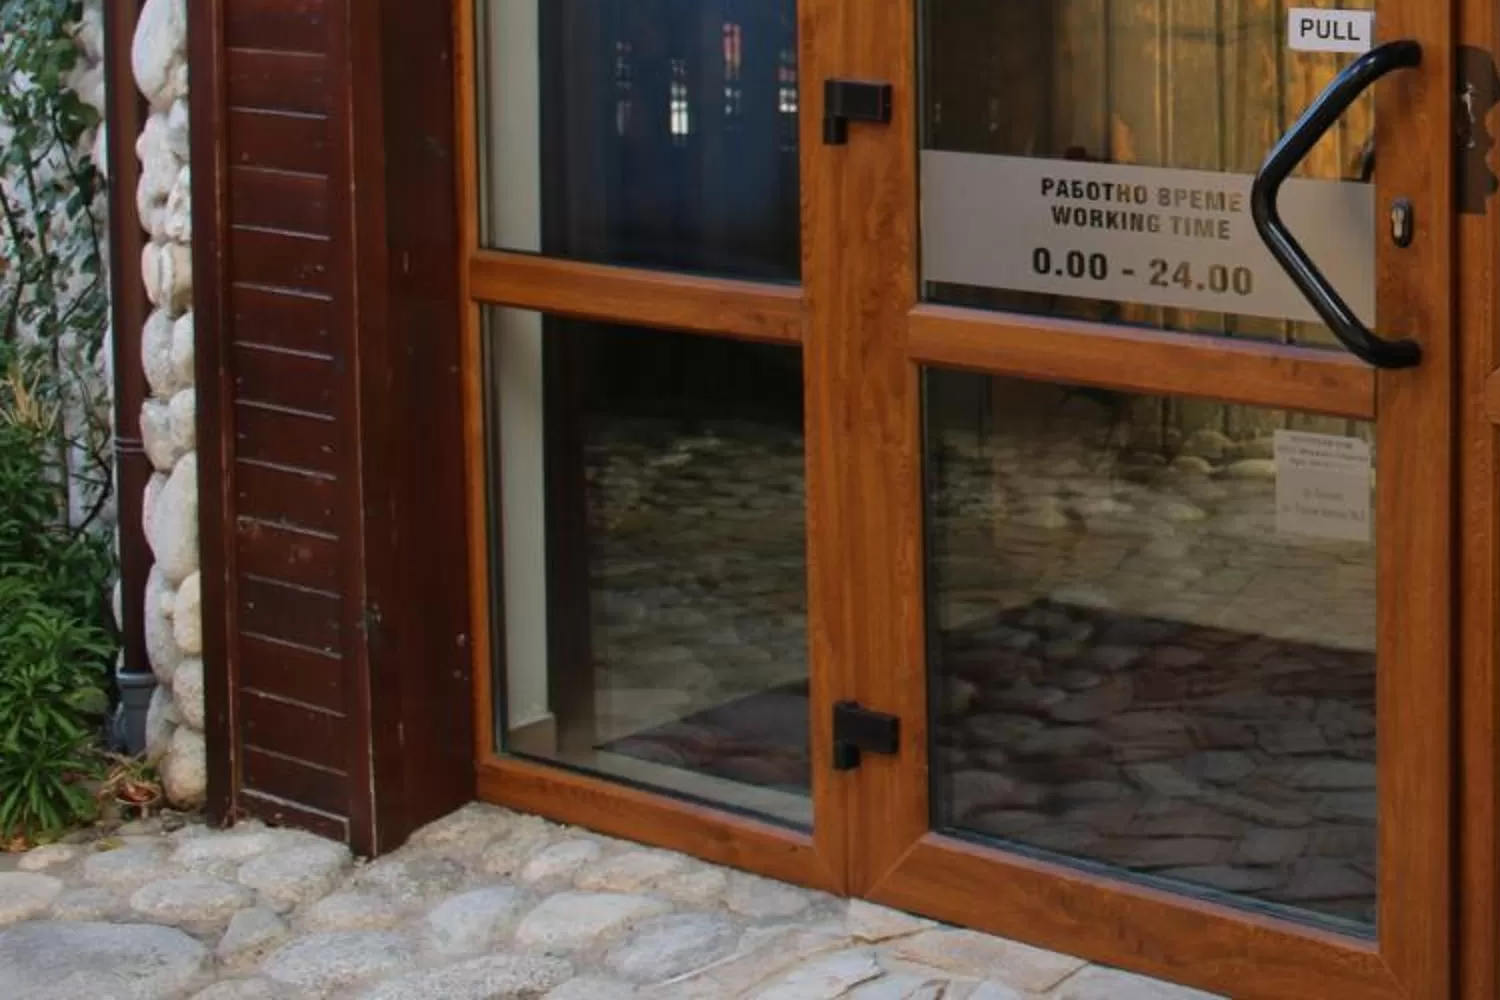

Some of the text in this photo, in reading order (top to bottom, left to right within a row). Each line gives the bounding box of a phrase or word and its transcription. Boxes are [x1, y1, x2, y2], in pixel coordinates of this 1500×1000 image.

[1300, 17, 1360, 41] PULL
[1040, 177, 1241, 213] РАБОТНО ВРЕМЕ
[1051, 205, 1231, 240] WORKING TIME
[1032, 246, 1108, 281] 0.00
[1149, 258, 1253, 296] 24.00
